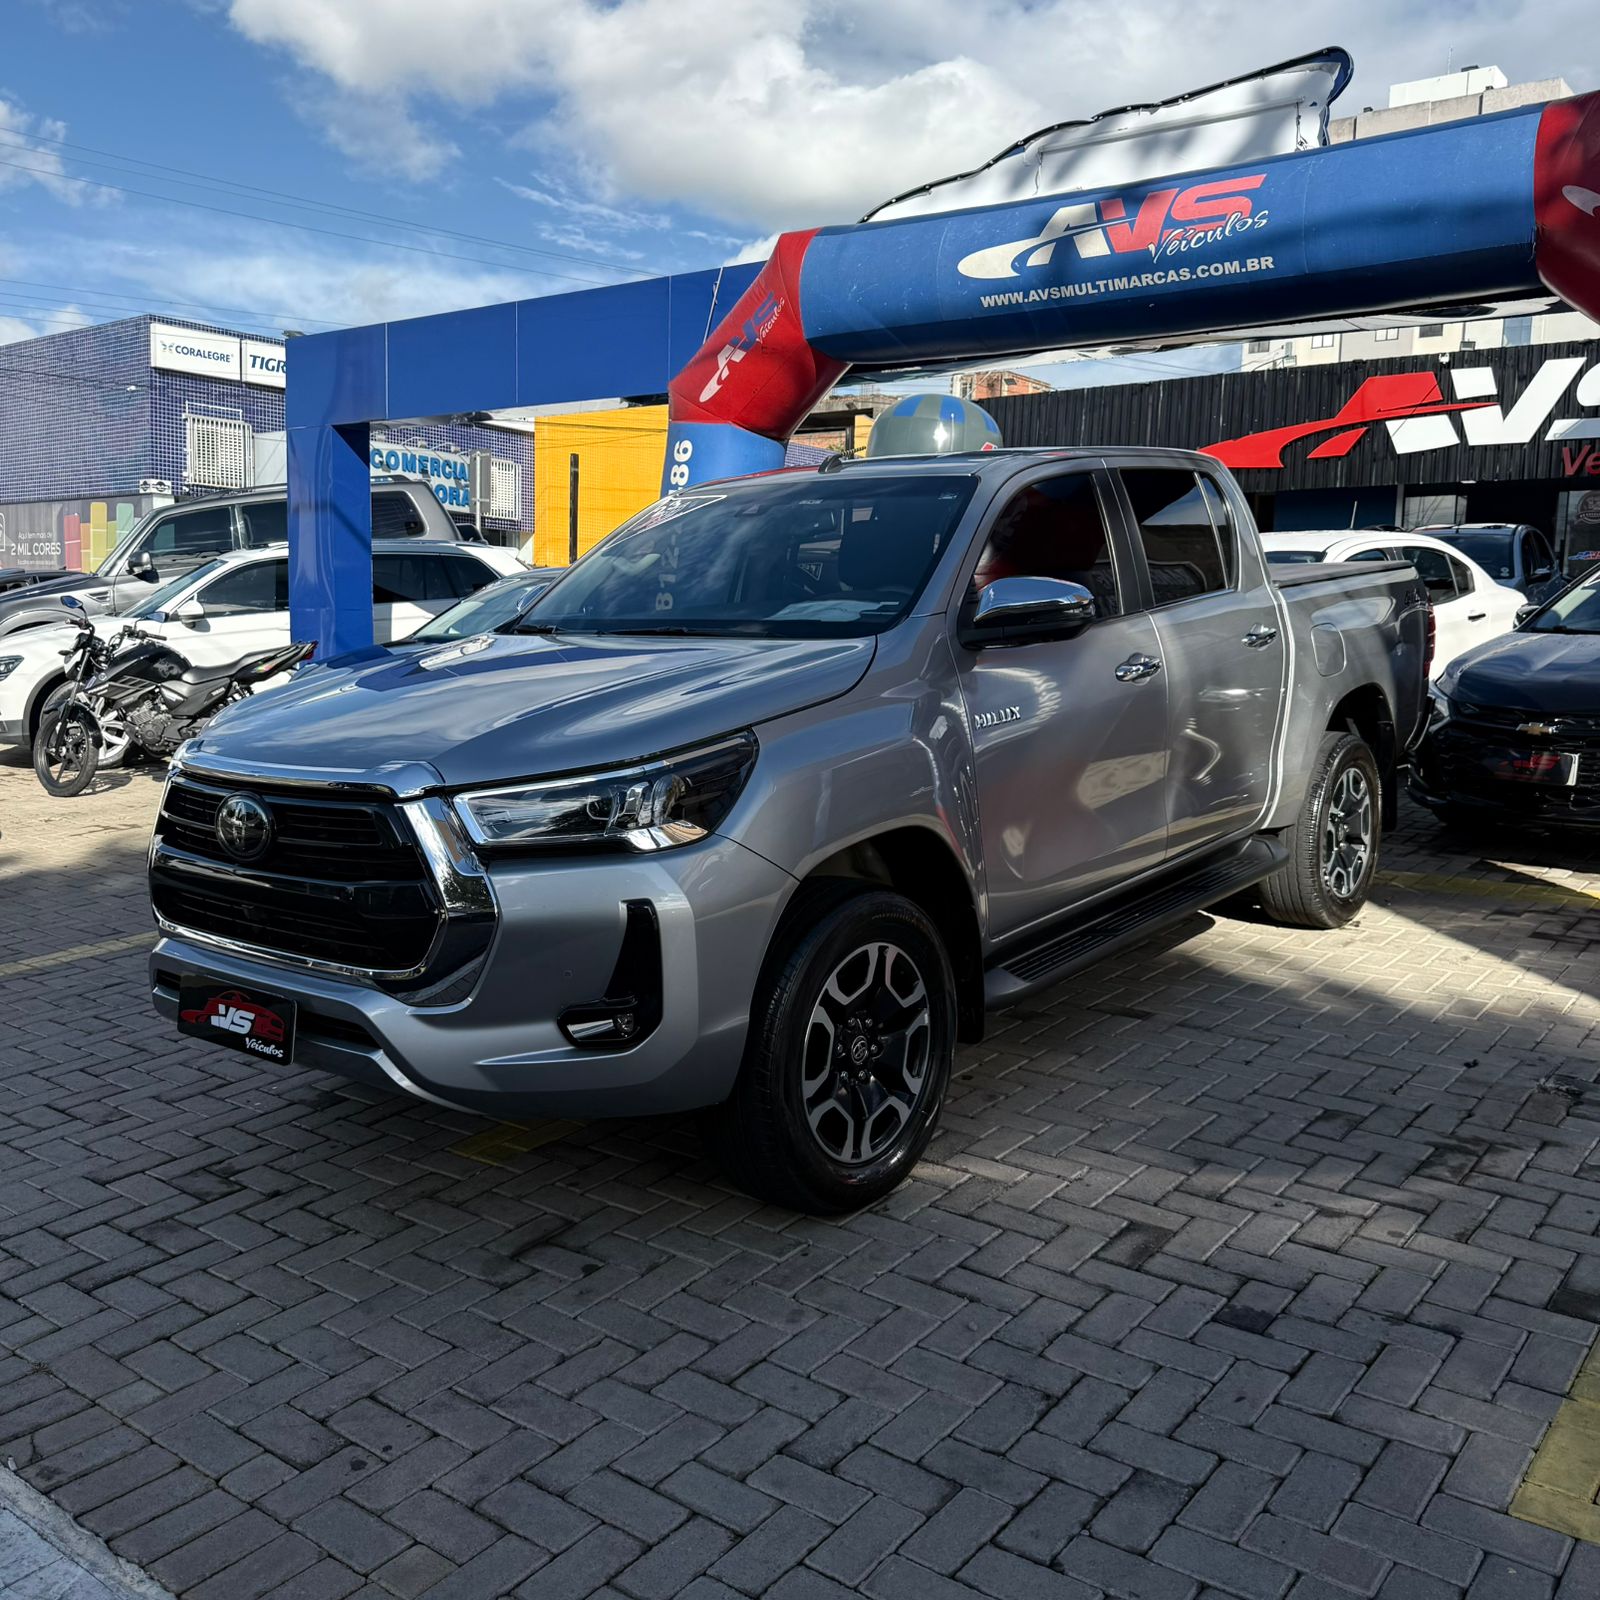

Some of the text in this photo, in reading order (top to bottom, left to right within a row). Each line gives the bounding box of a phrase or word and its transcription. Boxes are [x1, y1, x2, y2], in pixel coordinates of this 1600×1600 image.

[957, 174, 1267, 279] AVS
[981, 256, 1275, 307] WWW.AVSMULTIMARCAS.COM.BR
[175, 345, 231, 363] CORALEGRE
[370, 448, 469, 482] COMERCIA
[11, 542, 62, 556] 2 MIL CORES
[974, 706, 1021, 729] HILUX
